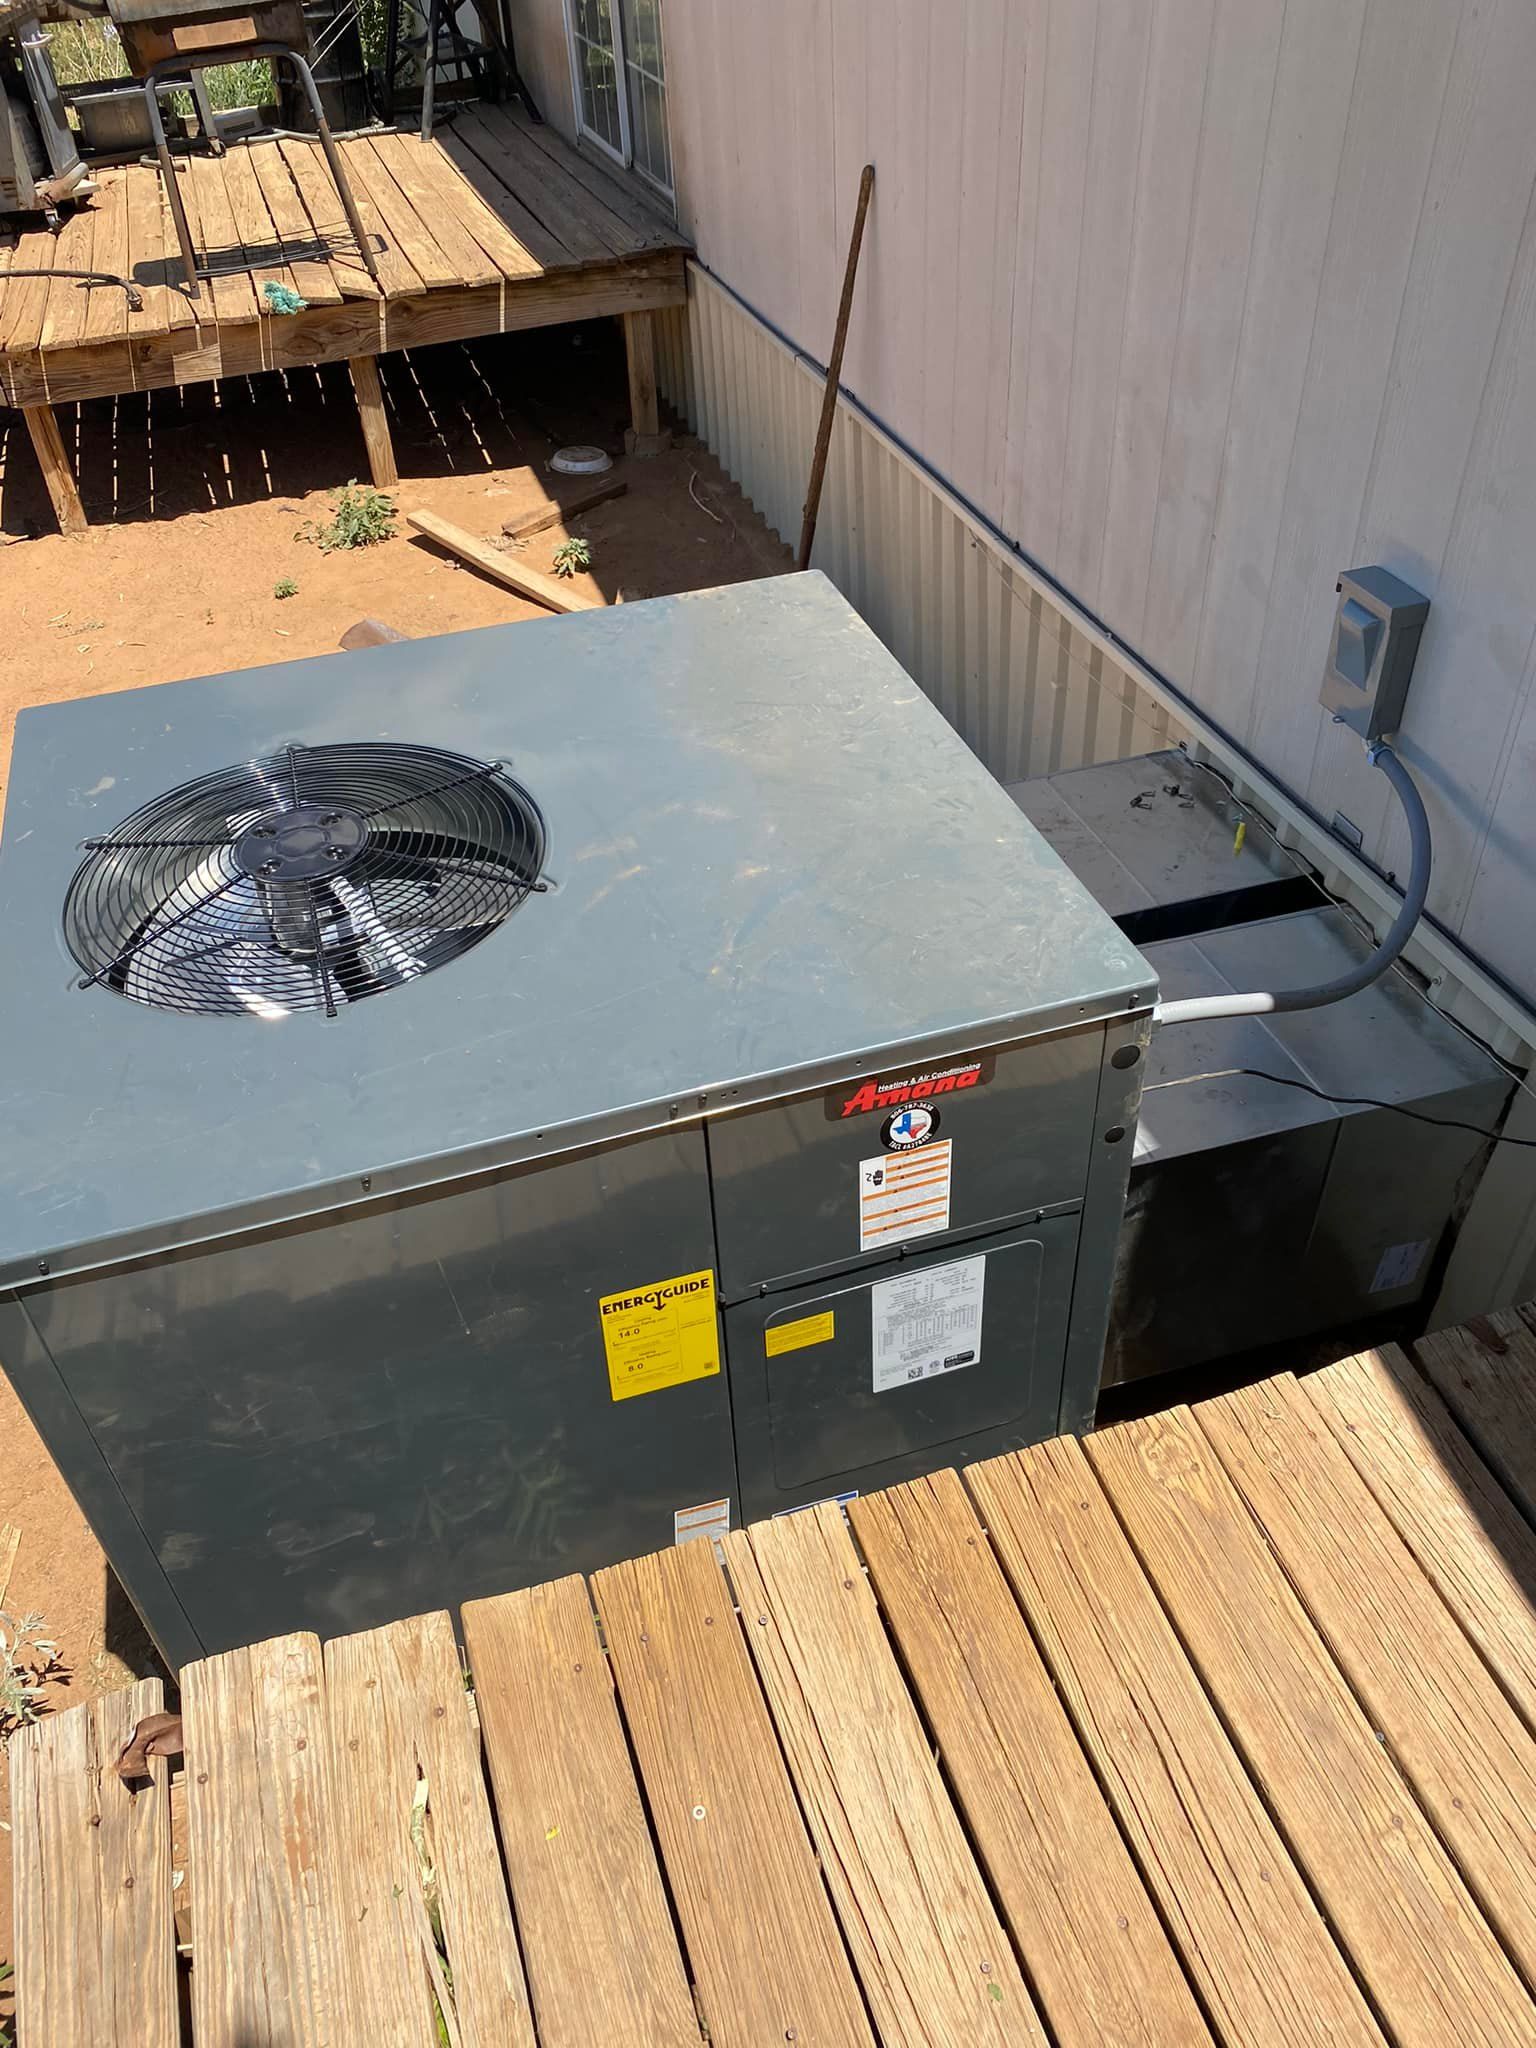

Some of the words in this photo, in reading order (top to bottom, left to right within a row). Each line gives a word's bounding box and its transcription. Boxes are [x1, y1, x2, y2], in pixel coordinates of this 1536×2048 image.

[841, 1070, 981, 1117] Amana
[878, 1079, 909, 1093] Heating
[909, 1078, 918, 1086] &
[919, 1073, 930, 1082] Air
[931, 1063, 981, 1079] Conditioning
[602, 1278, 710, 1315] ENERGYGUIDE
[618, 1328, 640, 1339] 14.0
